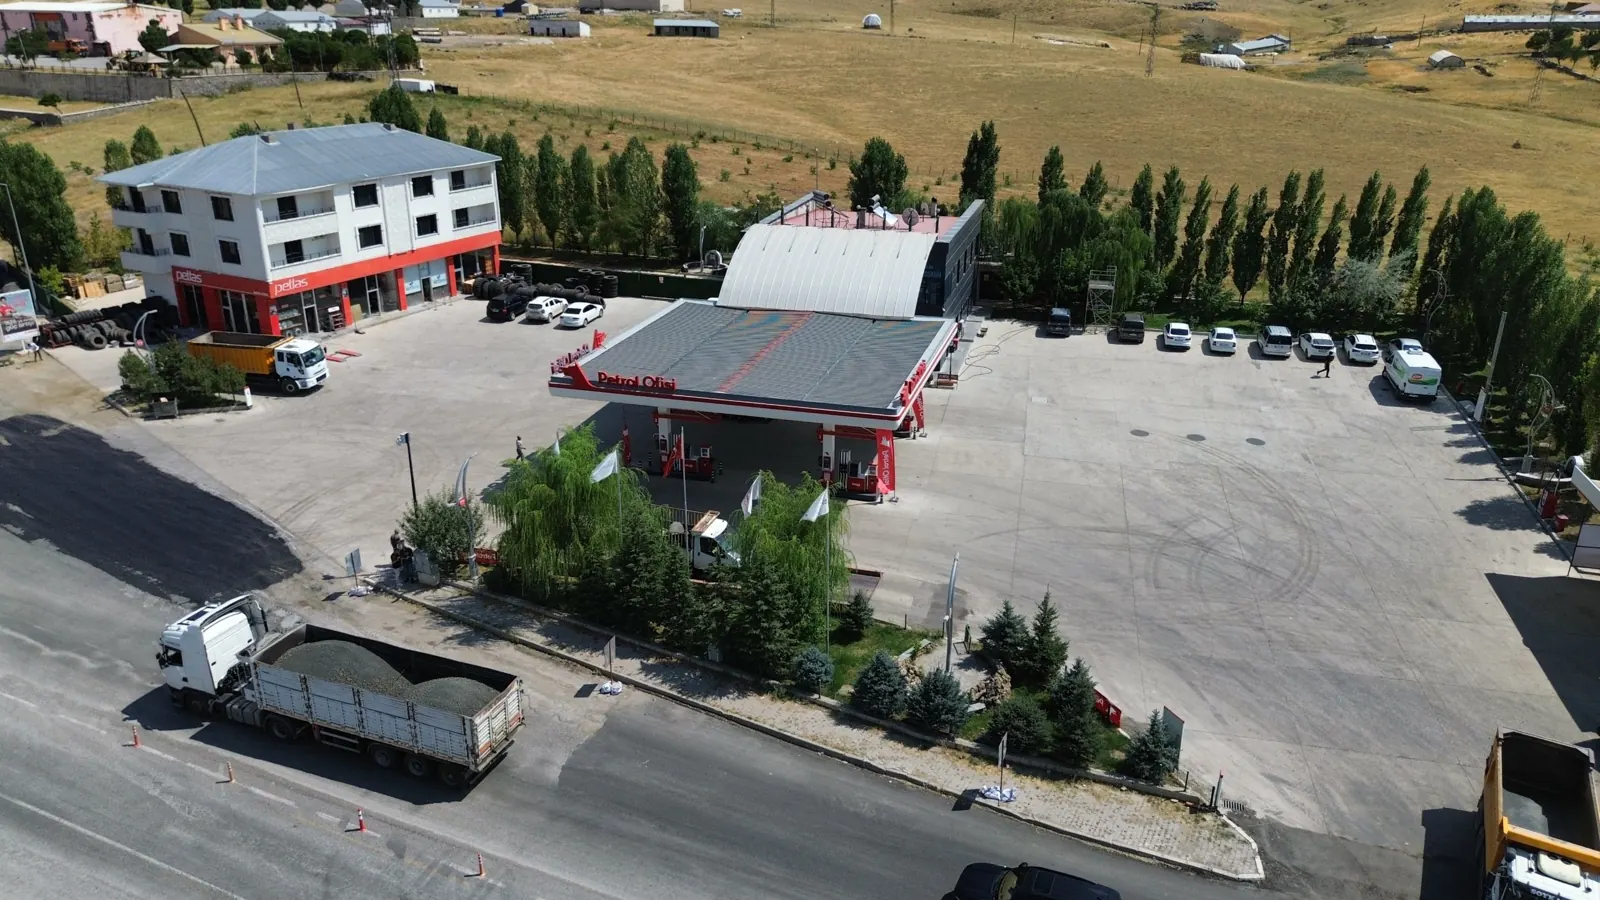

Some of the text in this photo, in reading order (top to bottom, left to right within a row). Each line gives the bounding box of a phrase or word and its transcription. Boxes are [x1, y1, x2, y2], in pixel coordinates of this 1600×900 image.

[176, 270, 202, 283] petlas
[274, 278, 309, 296] petlas
[597, 370, 677, 391] Petrol Ofisi
